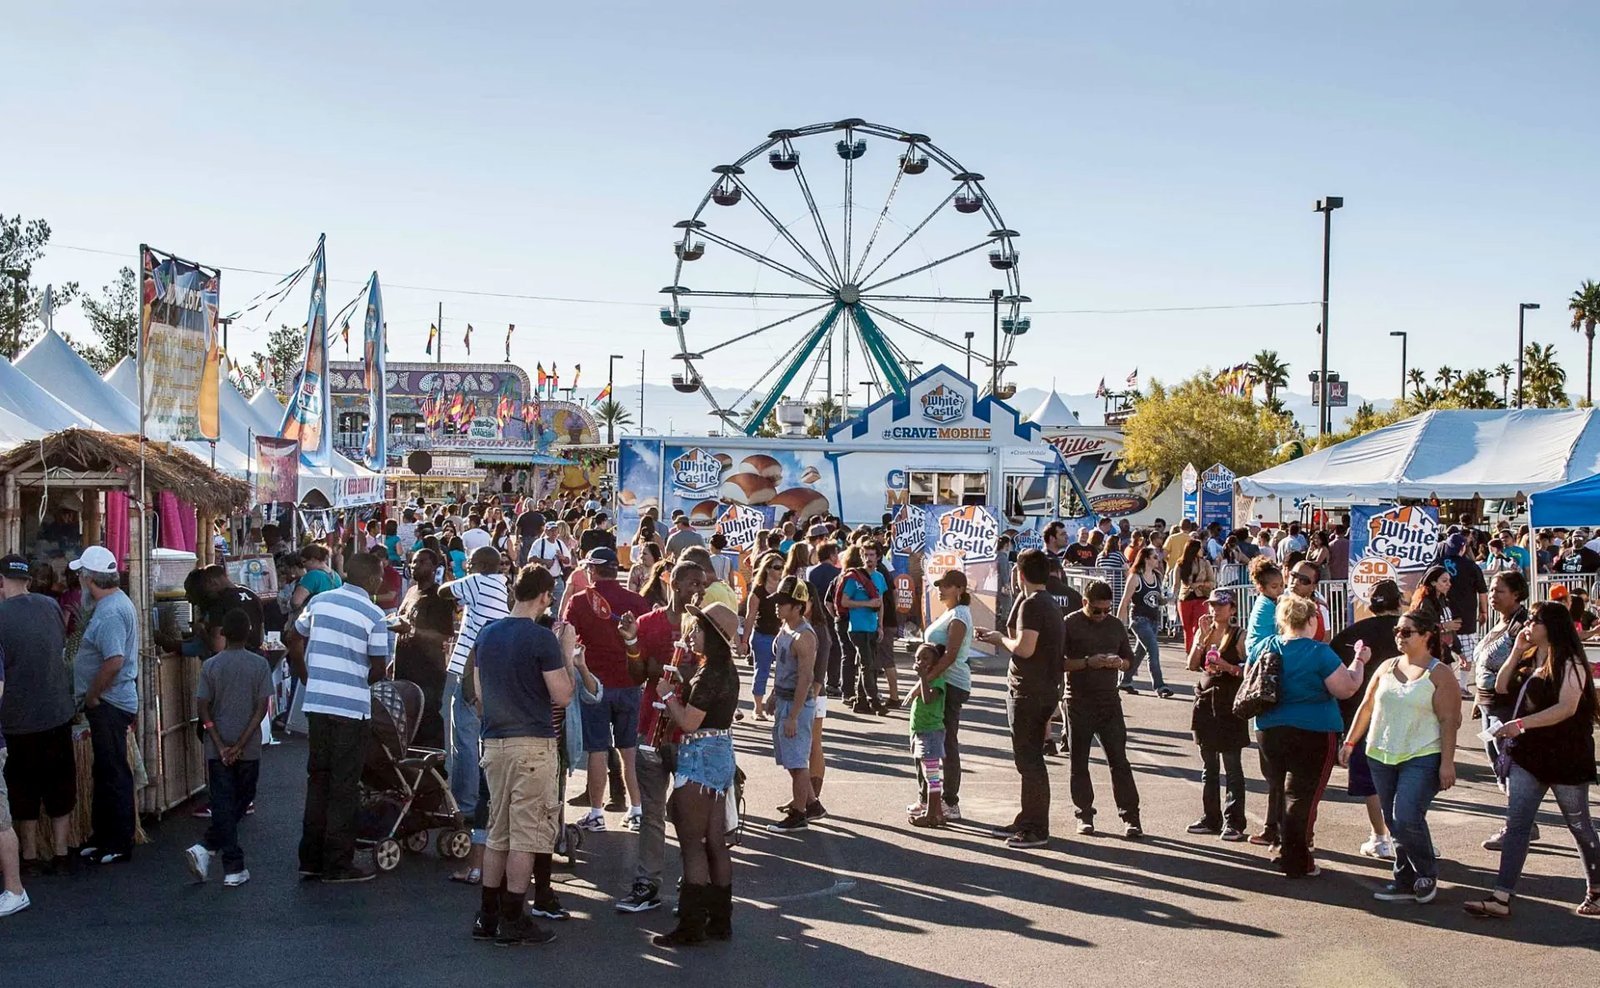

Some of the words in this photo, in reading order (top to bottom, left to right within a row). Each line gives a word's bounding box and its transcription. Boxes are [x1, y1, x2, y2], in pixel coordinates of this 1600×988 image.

[418, 372, 495, 393] GRAS
[927, 395, 960, 407] White
[924, 406, 961, 416] Castle
[1042, 437, 1105, 454] Miller
[679, 460, 715, 474] White
[676, 471, 717, 483] Castle
[1206, 472, 1232, 483] White
[1204, 481, 1232, 490] Castle
[720, 517, 758, 535] White
[895, 516, 924, 537] White
[948, 516, 995, 540] White
[1378, 518, 1435, 546] White
[895, 530, 926, 551] Castle
[942, 532, 994, 556] Castle
[1019, 534, 1043, 545] White
[1371, 537, 1434, 564] Castle
[932, 554, 956, 566] 30
[1359, 561, 1388, 574] 30
[898, 578, 909, 590] 10
[898, 590, 913, 598] ACK
